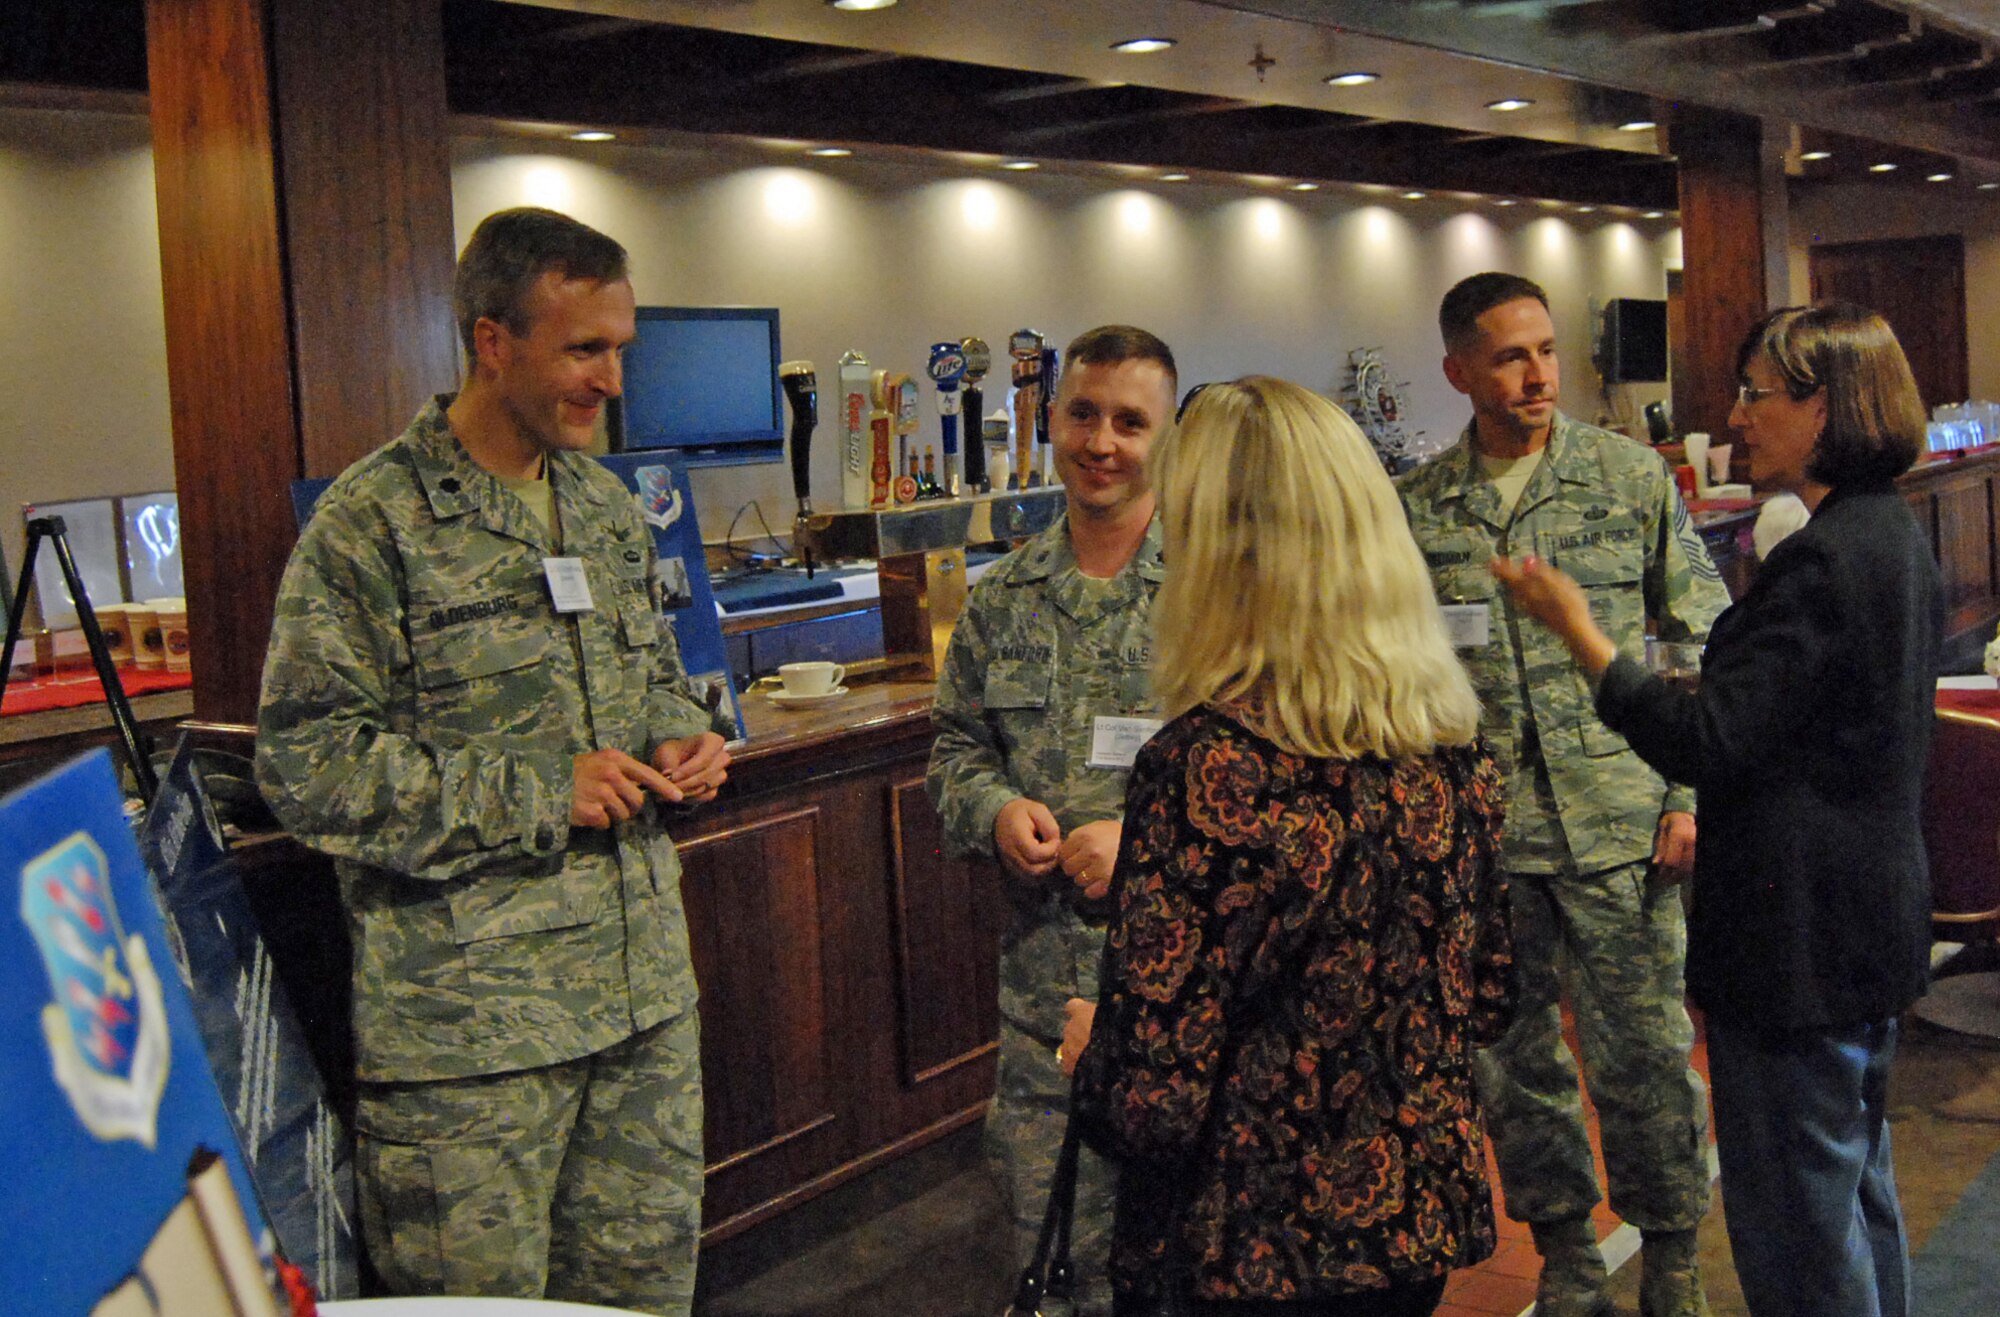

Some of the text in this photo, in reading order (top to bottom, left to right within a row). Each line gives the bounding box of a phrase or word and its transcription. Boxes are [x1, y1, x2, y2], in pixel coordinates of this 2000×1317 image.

[936, 360, 961, 377] Lite
[848, 432, 861, 477] LIGHT
[1583, 532, 1602, 545] AIR
[1605, 528, 1636, 542] FORCE
[429, 594, 518, 629] OLDENBURG
